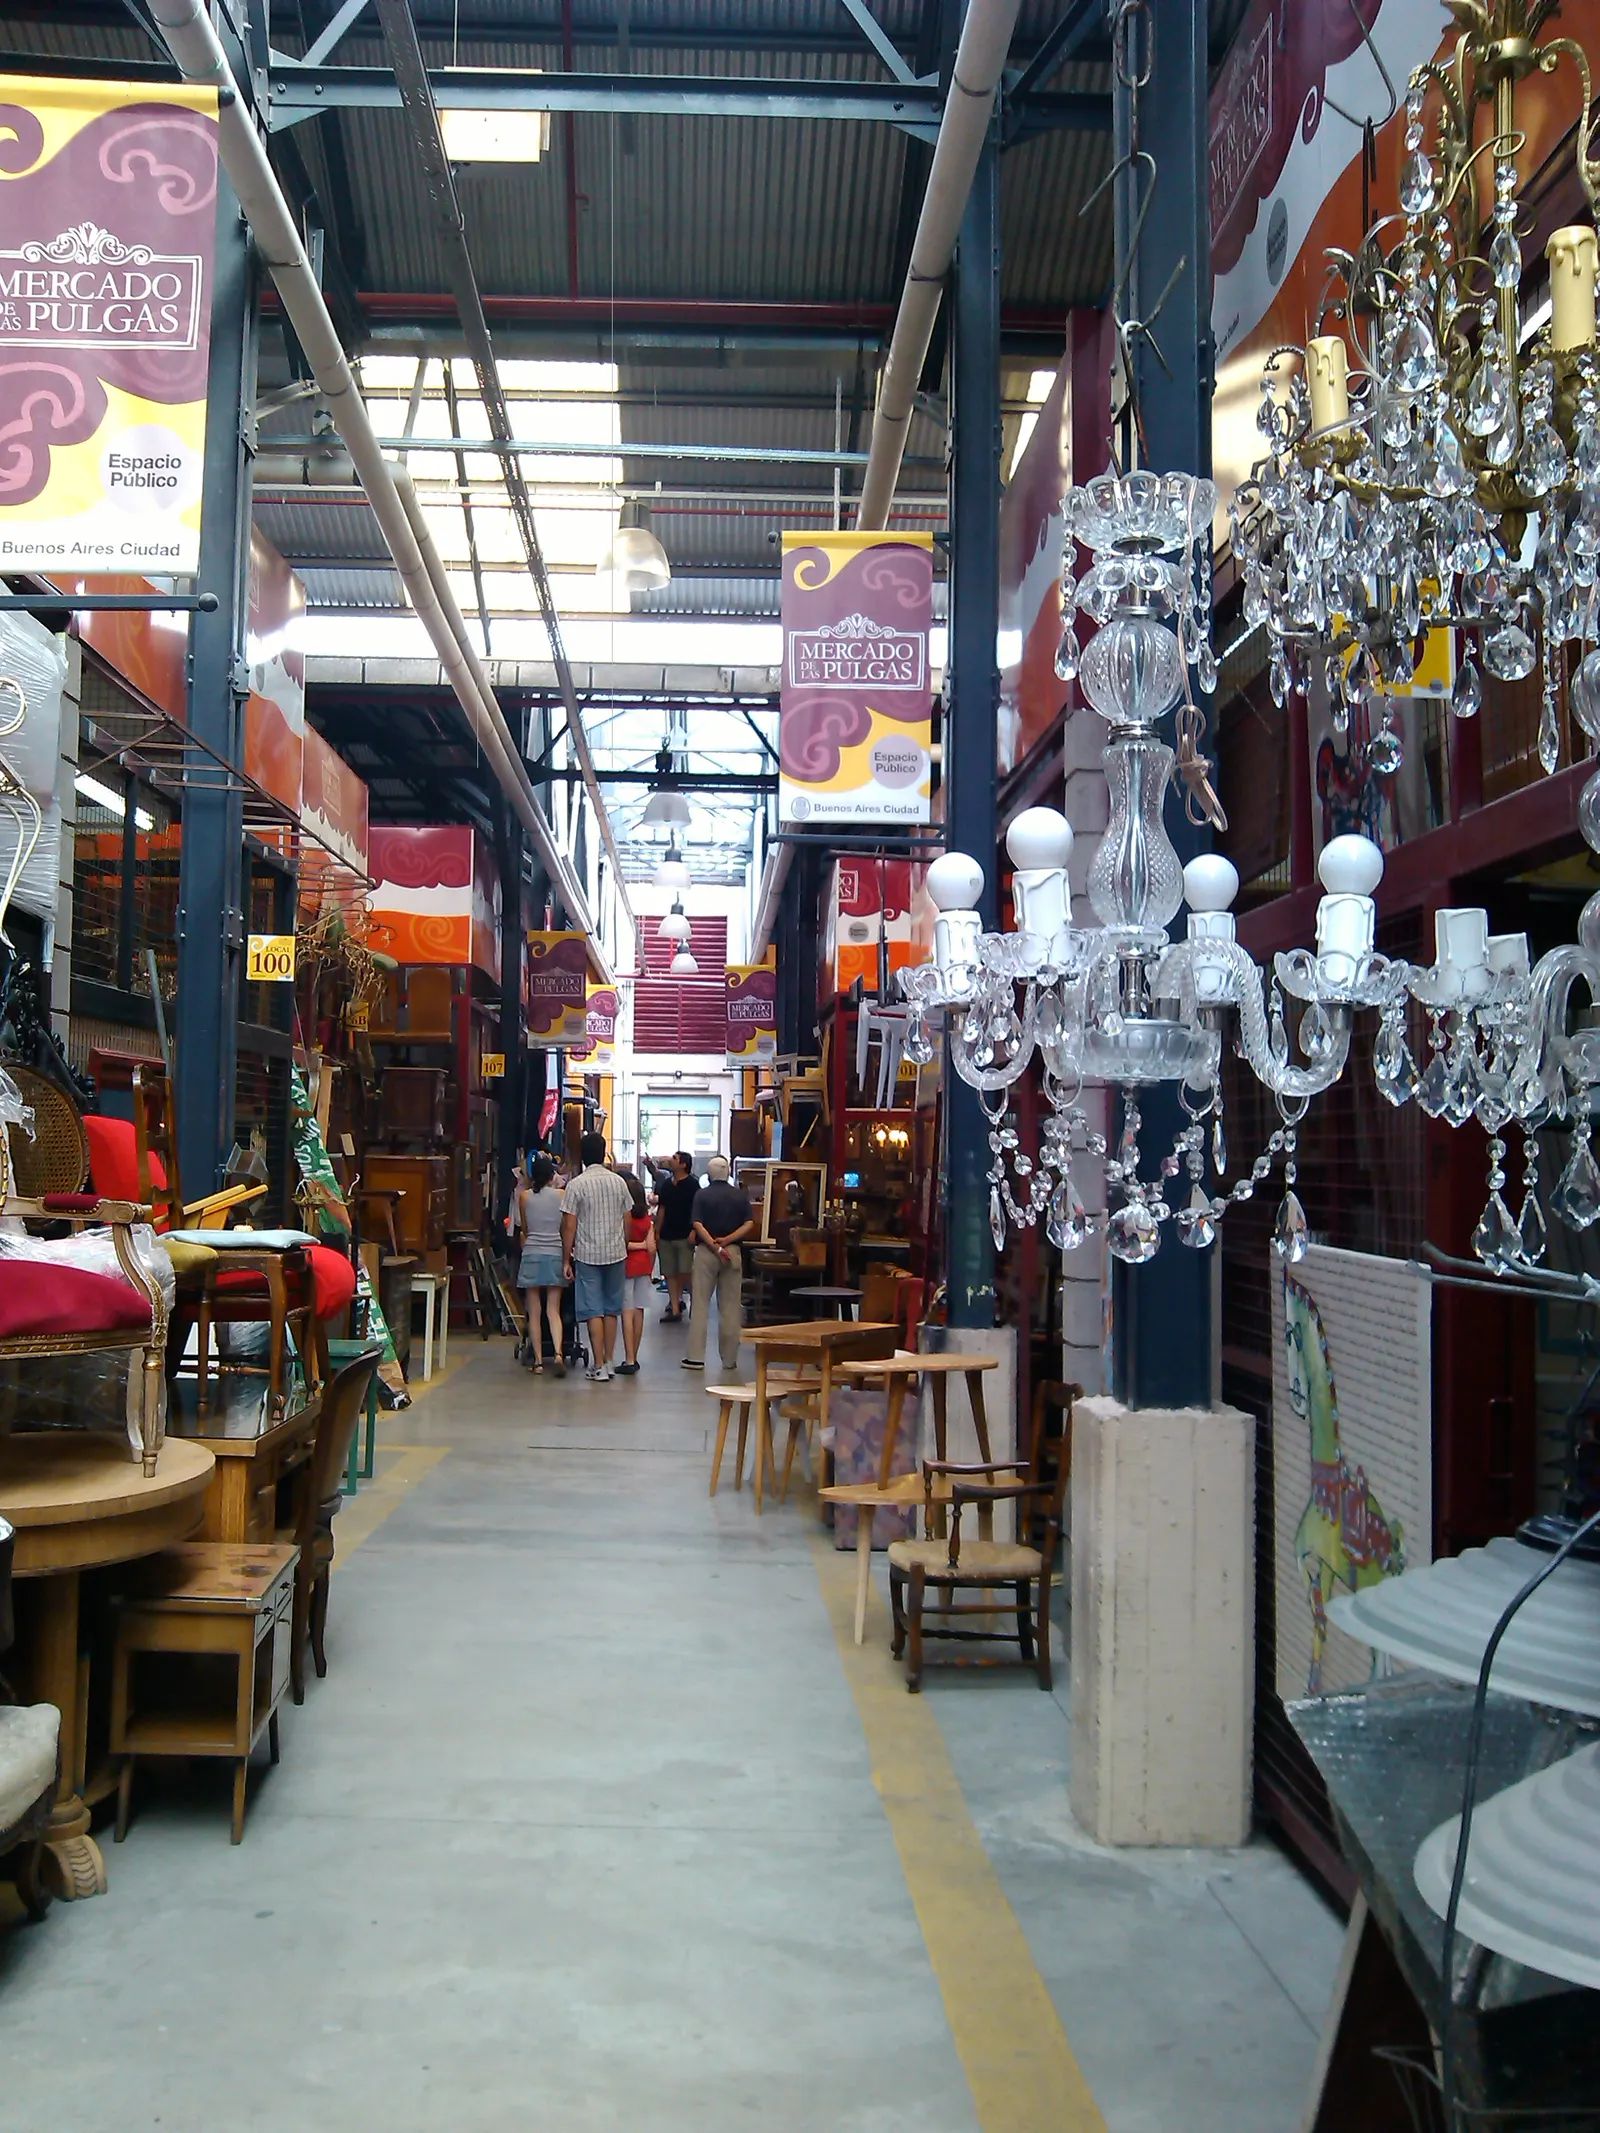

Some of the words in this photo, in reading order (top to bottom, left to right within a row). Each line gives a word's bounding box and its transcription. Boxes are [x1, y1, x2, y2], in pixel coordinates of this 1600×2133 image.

[0, 269, 182, 301] MERCADO
[0, 316, 22, 331] AS
[26, 302, 180, 333] PULGAS
[108, 453, 182, 472] Espacio
[110, 471, 178, 488] Público
[1, 541, 66, 555] Buenos
[70, 541, 115, 555] Aires
[120, 542, 181, 556] Ciudad
[800, 642, 914, 660] MERCADO
[800, 661, 817, 671] DE
[800, 670, 821, 679] LAS
[822, 661, 913, 680] PULGAS
[874, 751, 918, 763] Espacio
[875, 762, 916, 773] Público
[813, 803, 852, 813] Buenos
[854, 804, 881, 813] Aires
[883, 804, 920, 814] Ciudad
[252, 953, 291, 974] 100
[535, 977, 580, 985] MERCADO
[543, 985, 580, 993] PULGAS
[484, 1062, 503, 1074] 107
